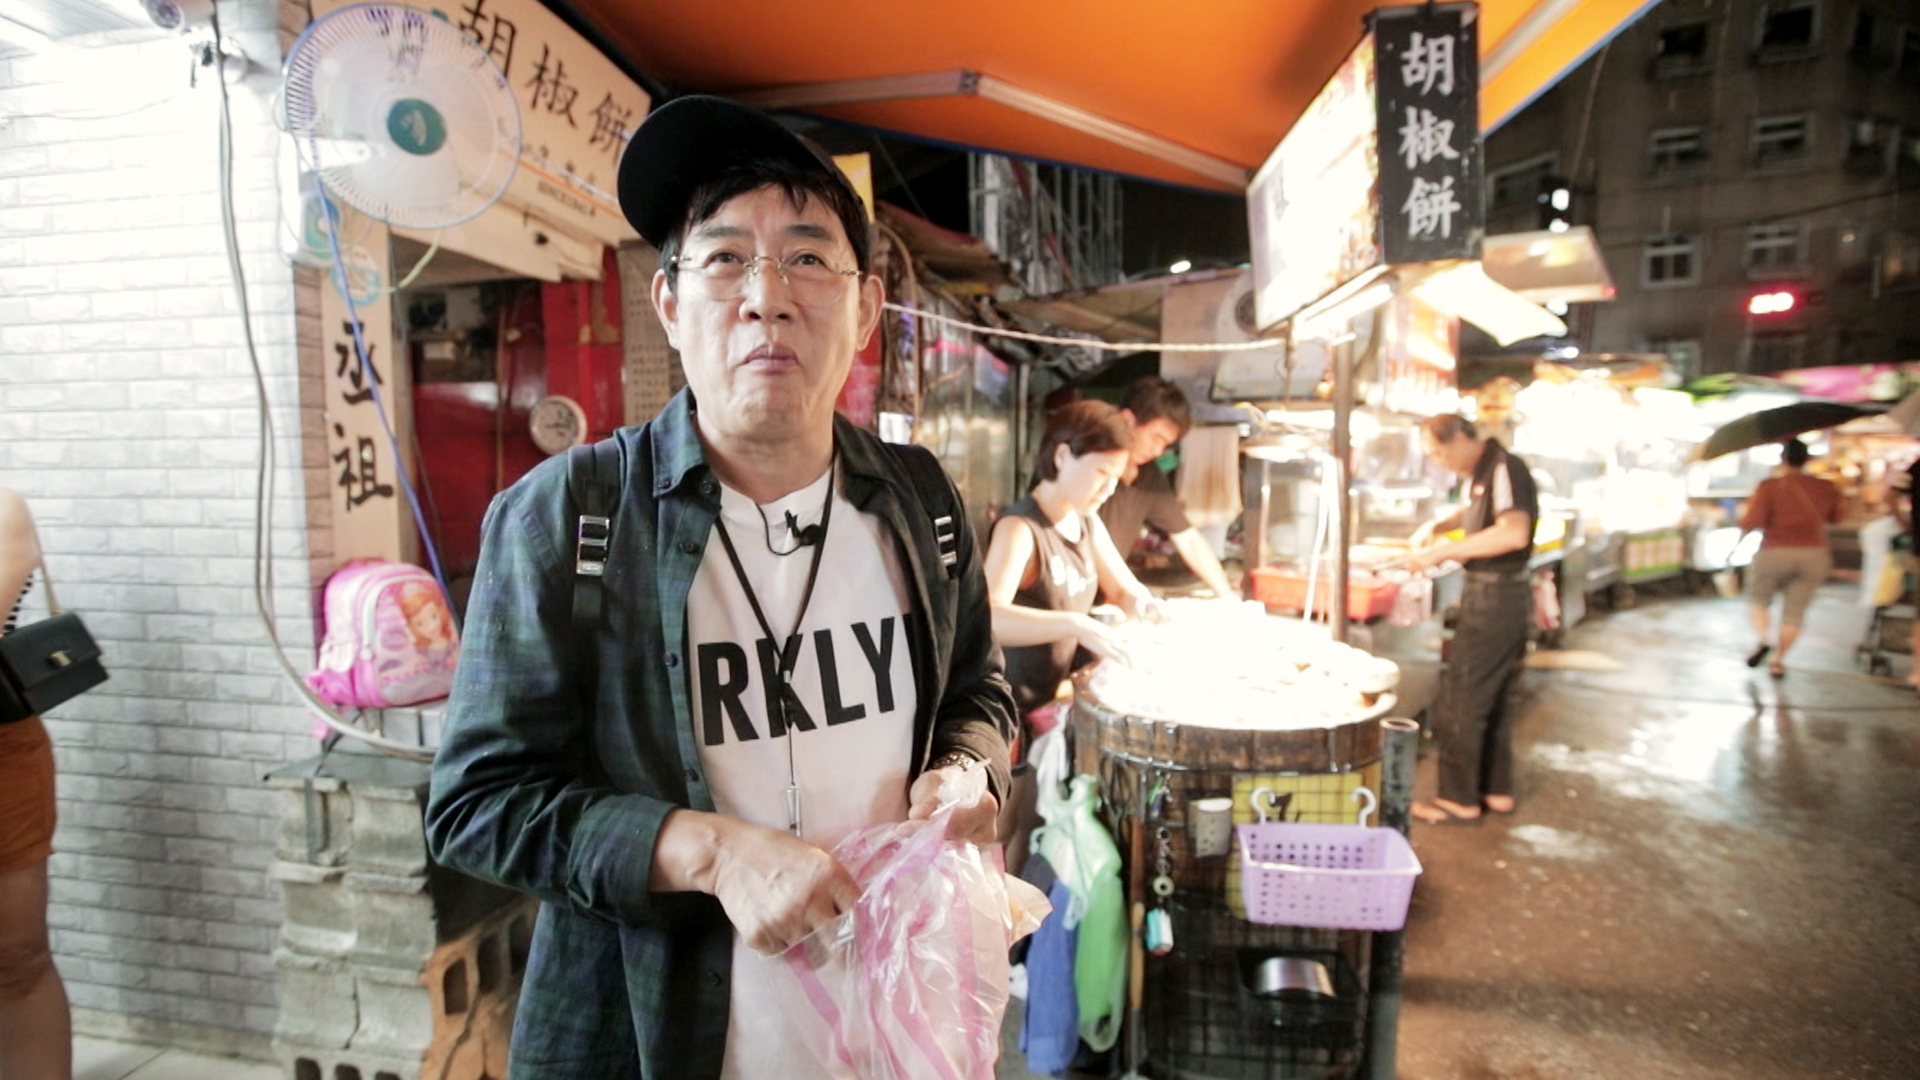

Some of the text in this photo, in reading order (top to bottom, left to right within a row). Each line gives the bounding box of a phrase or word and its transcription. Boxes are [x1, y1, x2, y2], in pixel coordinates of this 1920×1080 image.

[459, 0, 630, 168] 胡椒餅
[1397, 31, 1461, 239] 胡椒餅
[332, 317, 394, 512] 丞祖
[697, 613, 914, 746] RKLY
